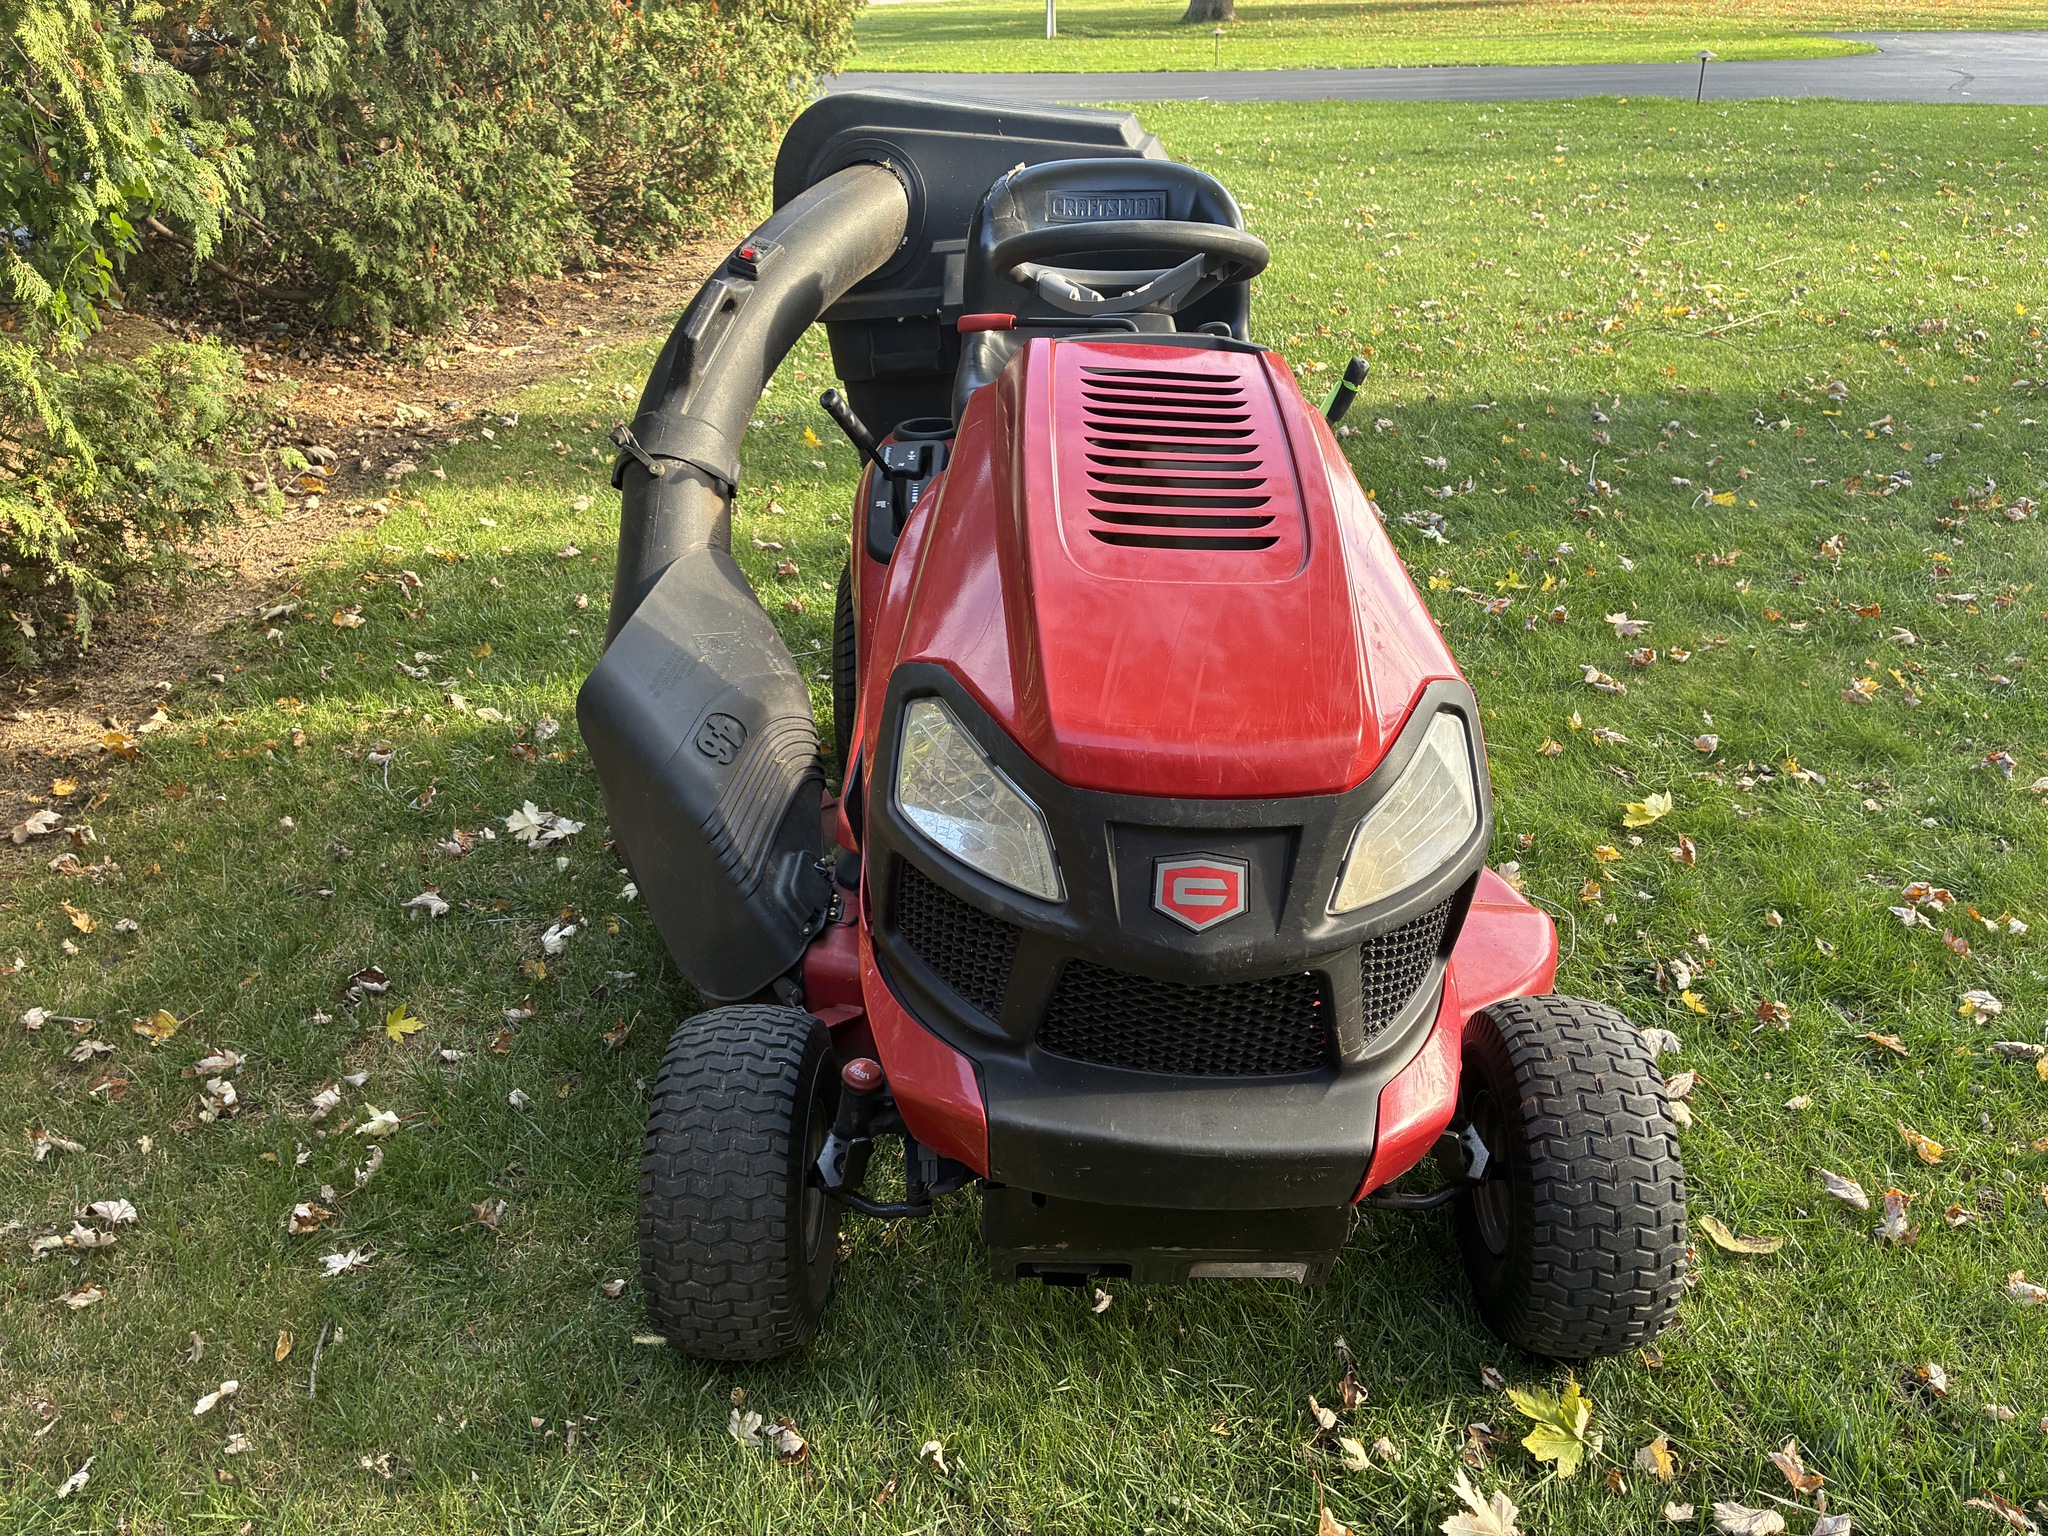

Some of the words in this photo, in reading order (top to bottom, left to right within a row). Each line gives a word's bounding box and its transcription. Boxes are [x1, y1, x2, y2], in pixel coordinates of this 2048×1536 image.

[1052, 198, 1161, 217] CRAFTSMAN
[696, 714, 741, 765] 46
[849, 1065, 870, 1080] IRON
